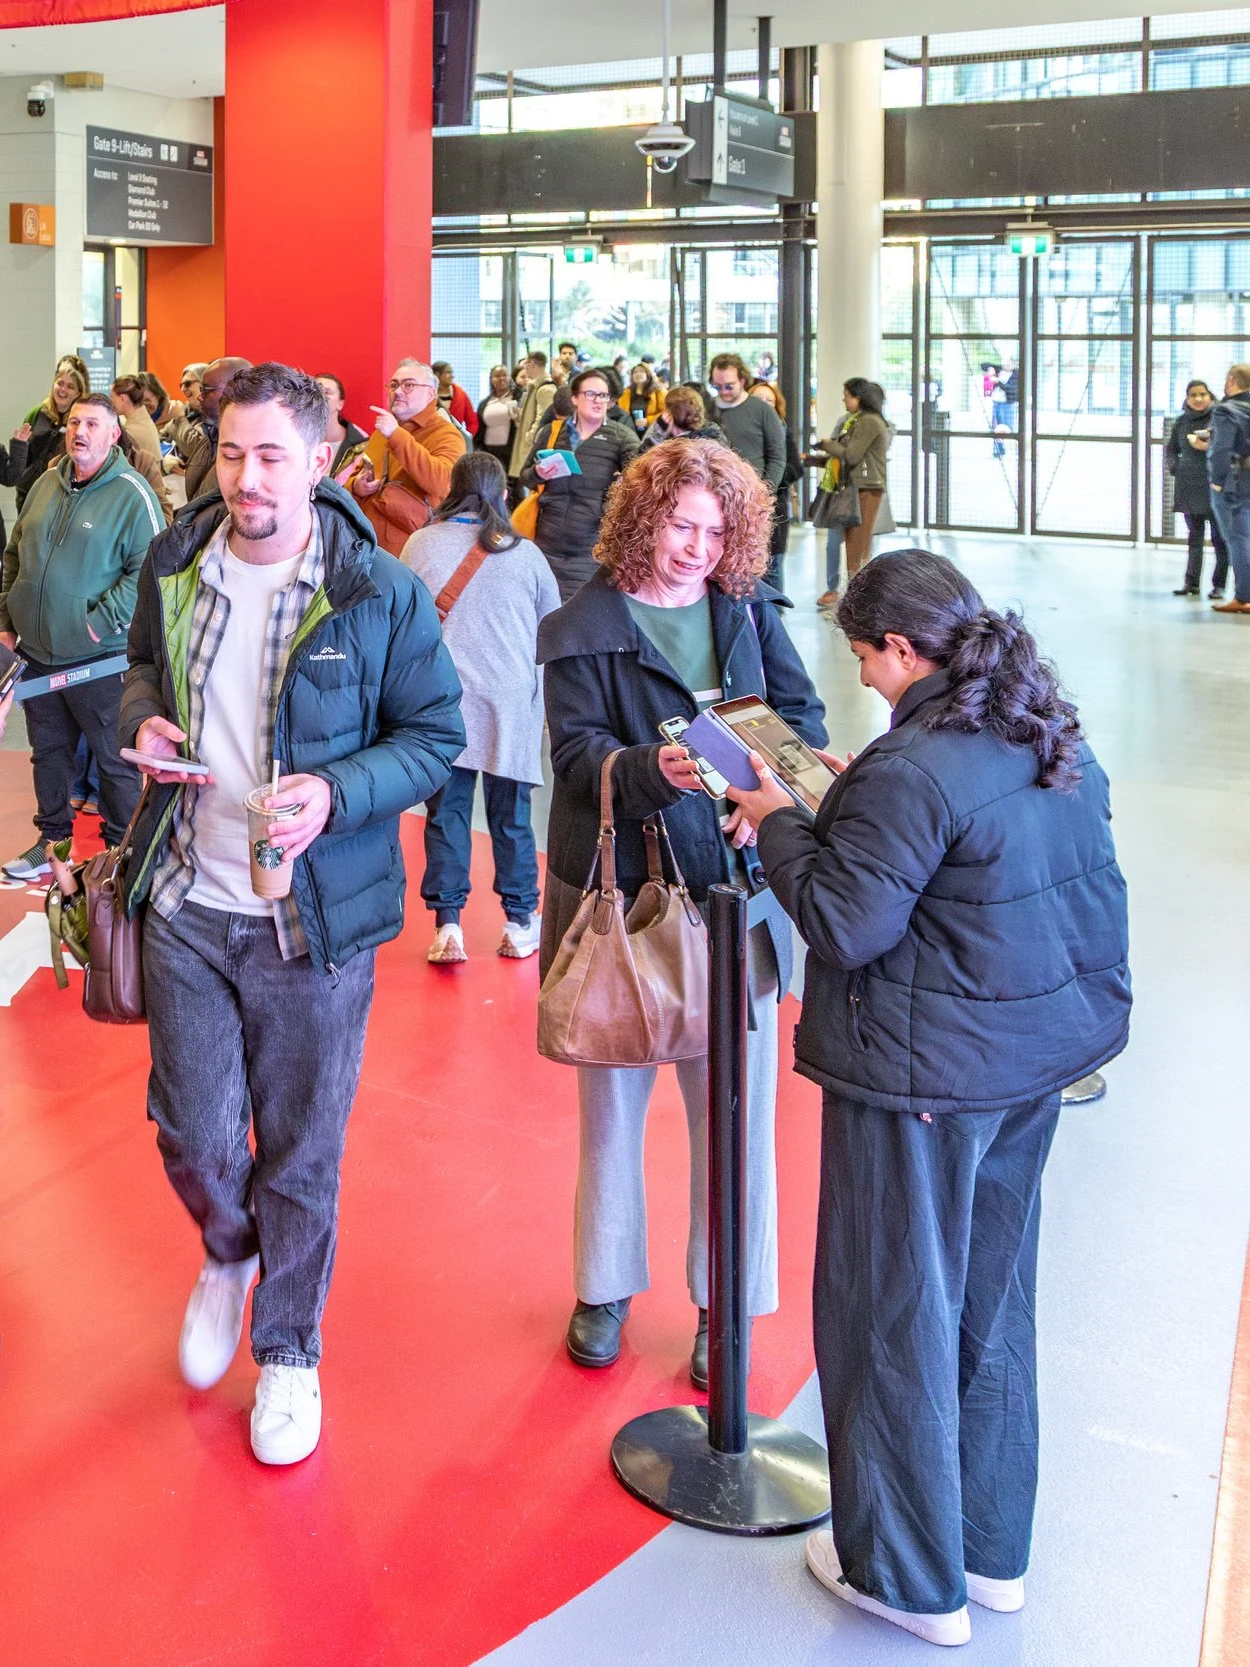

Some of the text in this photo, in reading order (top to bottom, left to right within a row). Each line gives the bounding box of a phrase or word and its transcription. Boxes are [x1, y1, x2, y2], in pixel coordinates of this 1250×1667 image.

[93, 135, 110, 152] Gate
[309, 652, 346, 660] Kathmandu
[50, 667, 90, 689] MARVEL STADIUM
